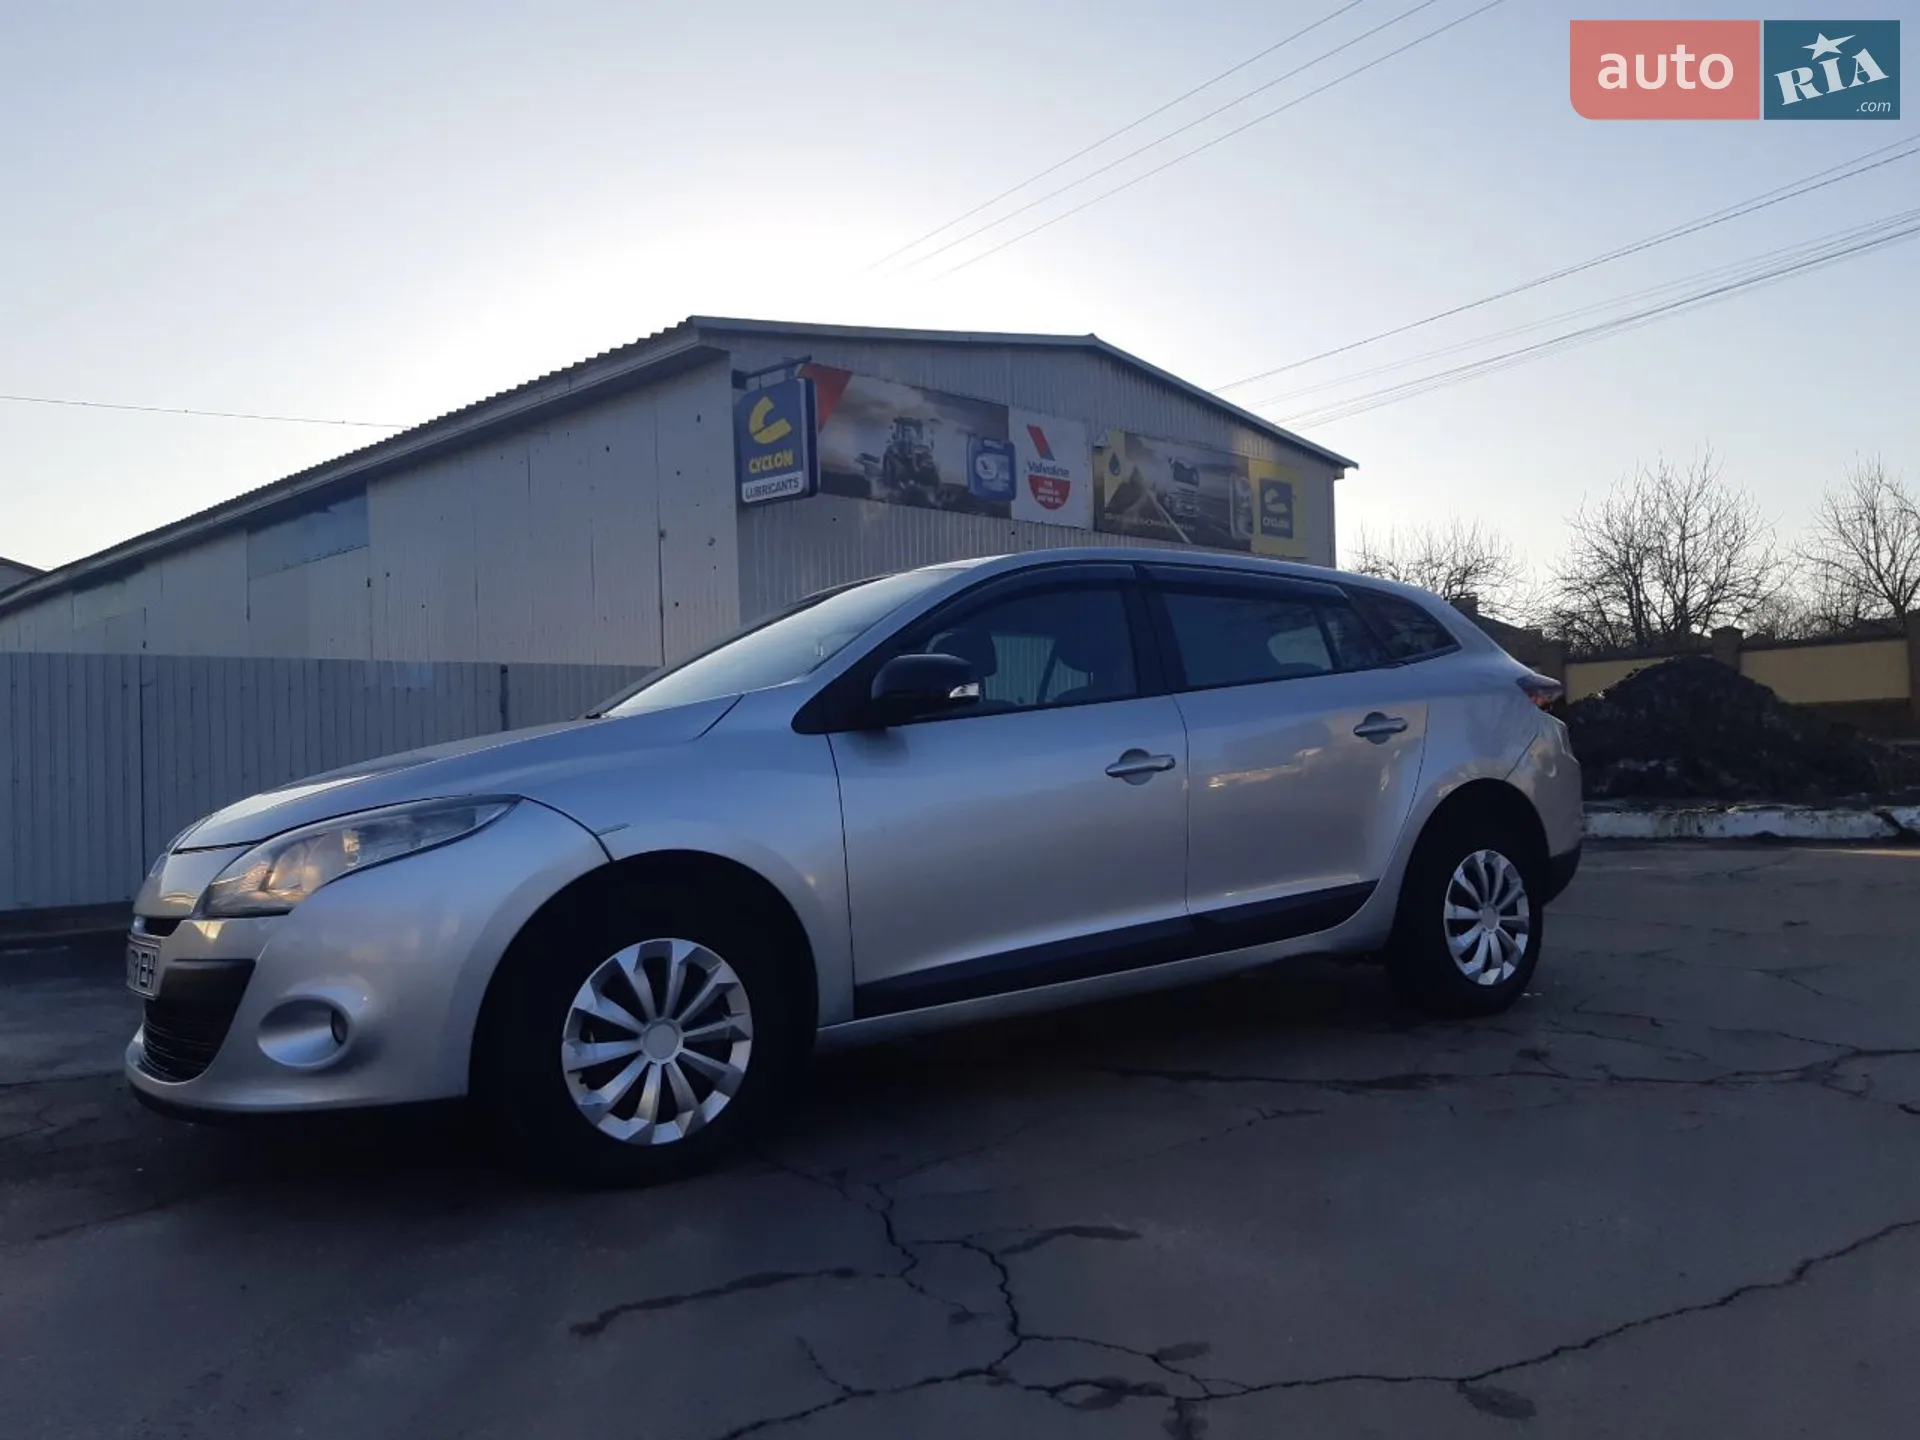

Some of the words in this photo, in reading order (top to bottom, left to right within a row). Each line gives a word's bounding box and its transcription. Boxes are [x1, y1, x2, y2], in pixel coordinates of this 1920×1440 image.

[749, 450, 793, 473] CYCLON
[1027, 459, 1070, 478] Valvoline
[746, 478, 799, 498] LUBRICANTS
